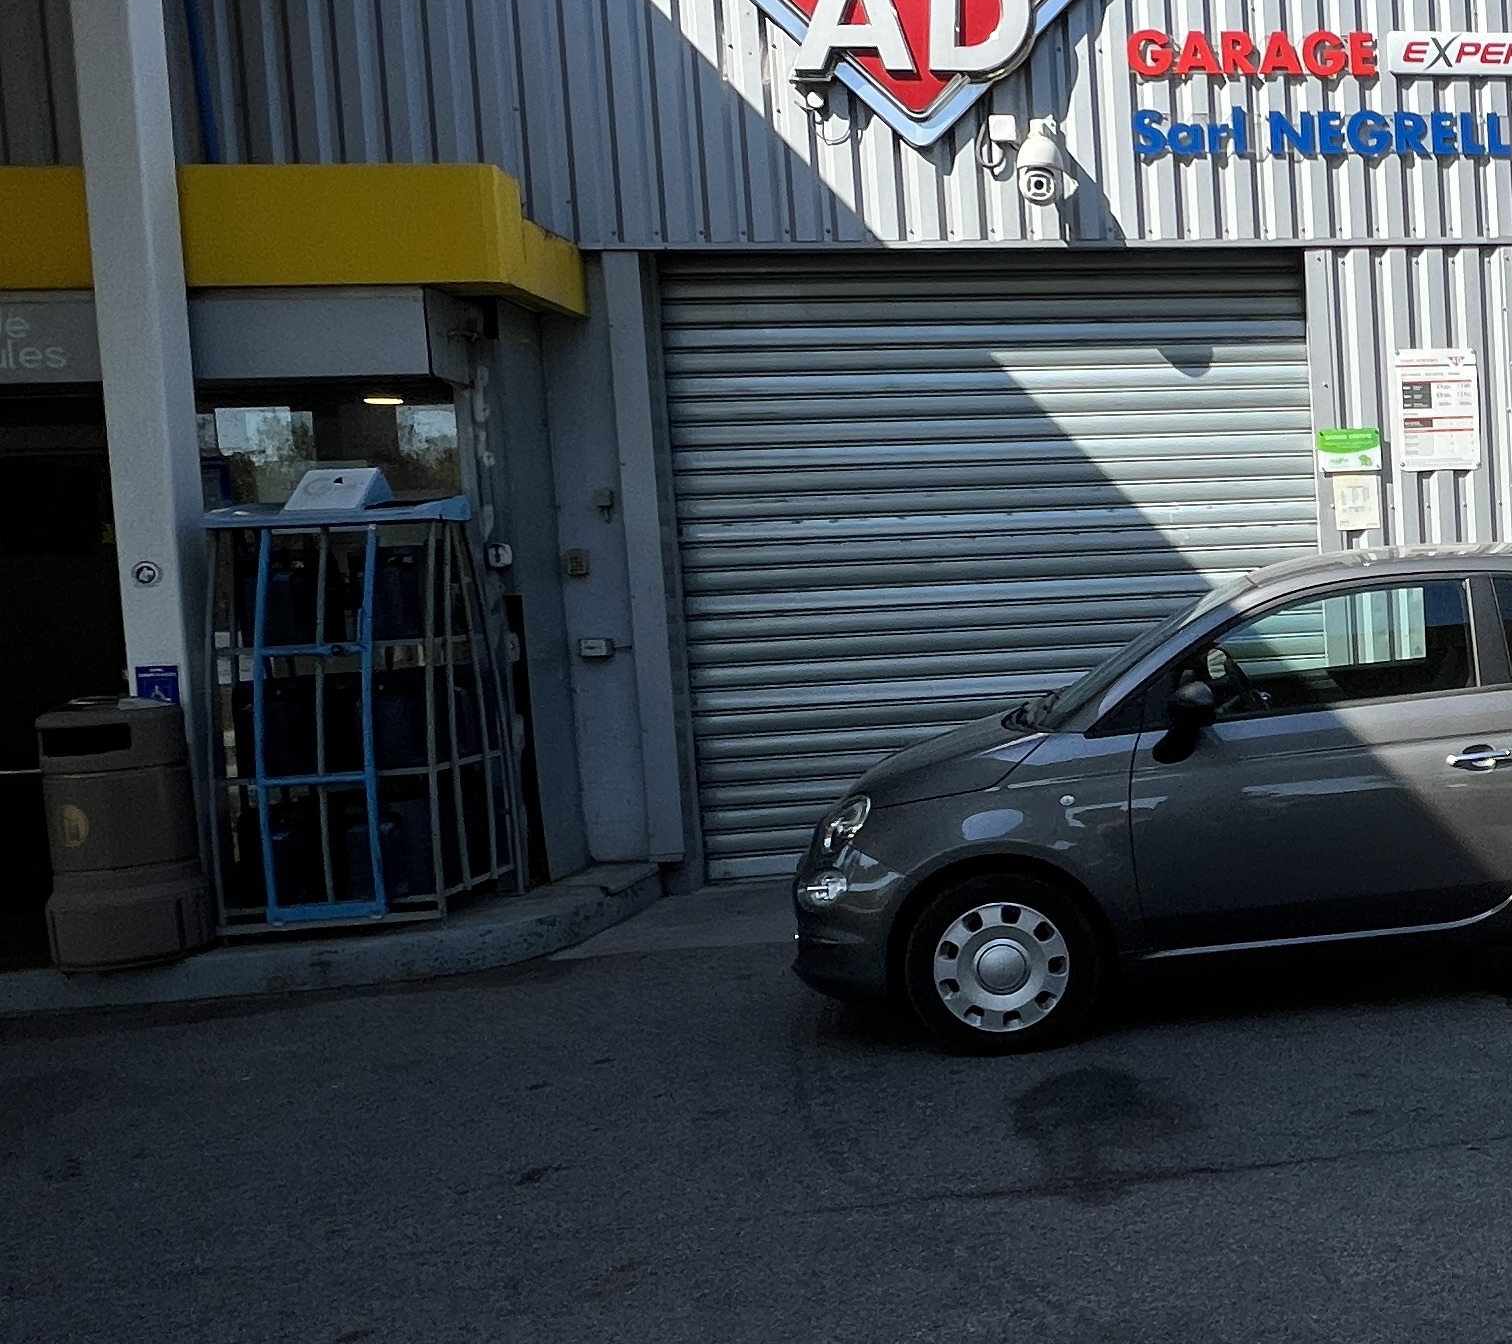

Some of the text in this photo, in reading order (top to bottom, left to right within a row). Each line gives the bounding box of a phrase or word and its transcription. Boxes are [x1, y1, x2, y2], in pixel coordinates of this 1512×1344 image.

[1128, 30, 1376, 76] GARAGE
[1133, 108, 1245, 156] Sarl
[1269, 110, 1512, 156] NEGRELL
